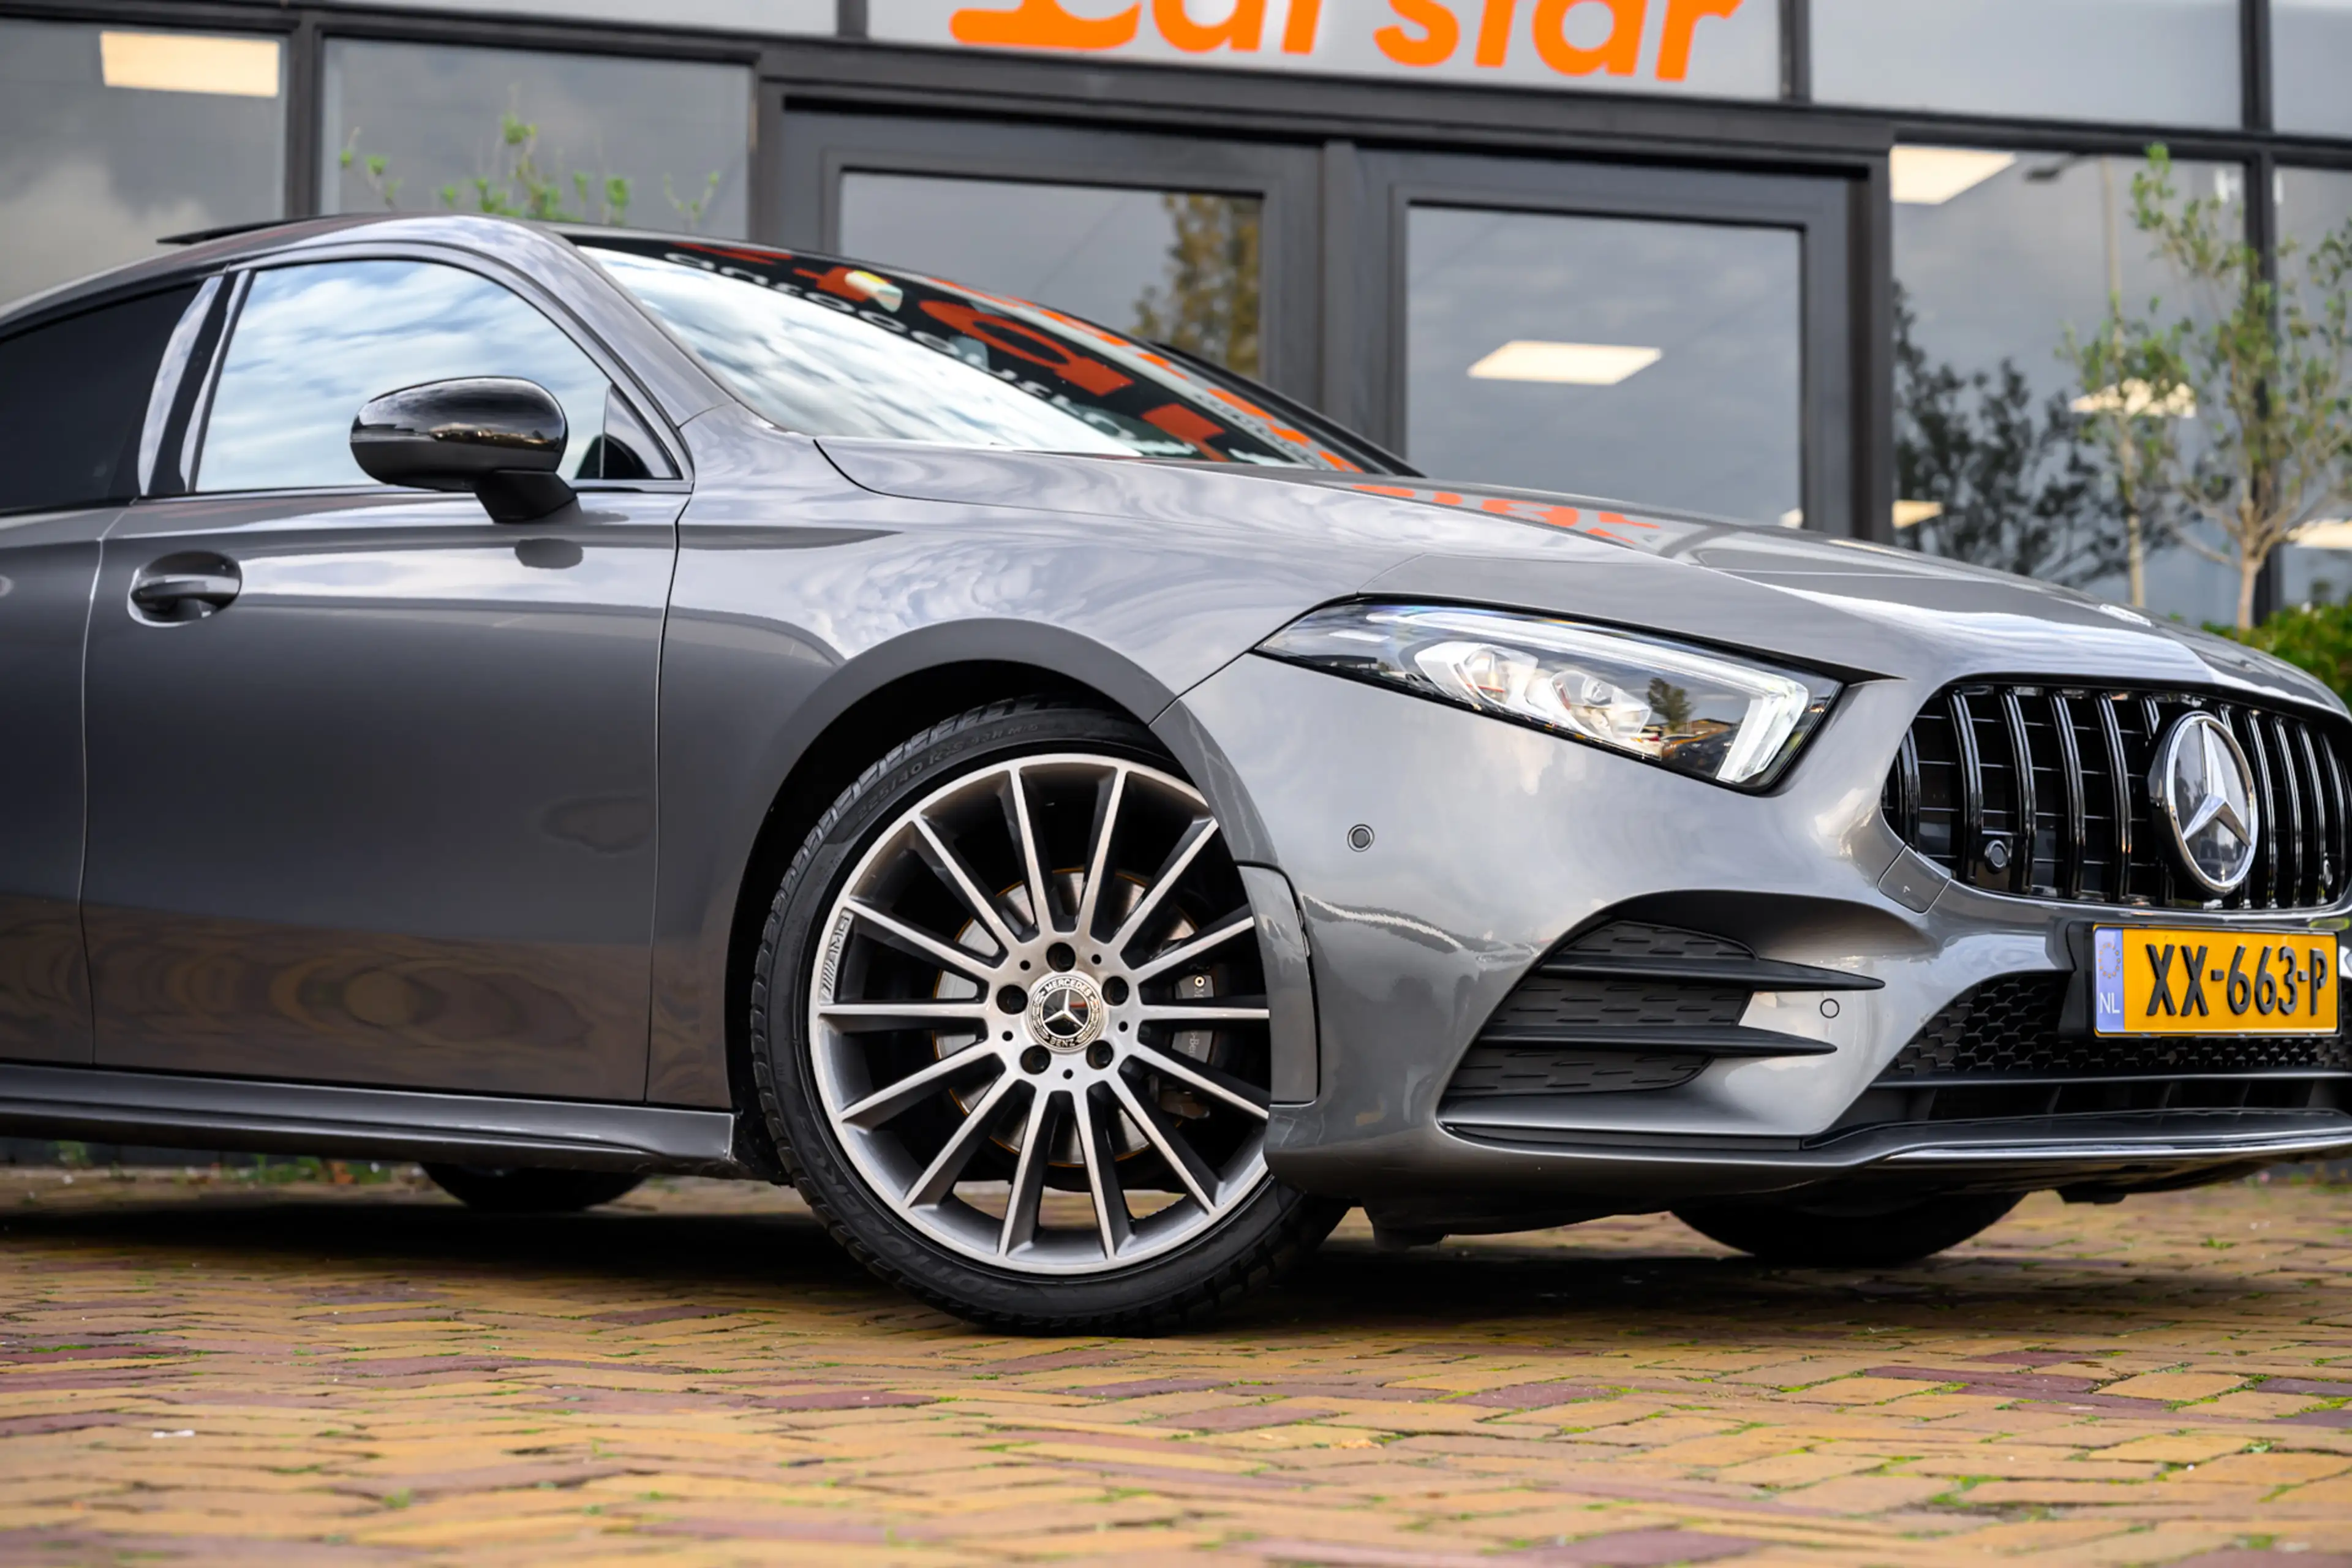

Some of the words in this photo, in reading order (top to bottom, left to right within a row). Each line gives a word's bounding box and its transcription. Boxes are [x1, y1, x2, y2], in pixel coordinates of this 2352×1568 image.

[1044, 979, 1093, 997] MERCEDES
[2145, 943, 2328, 1017] XX-663-P
[2099, 992, 2120, 1014] NL
[1050, 1037, 1076, 1047] BENZ
